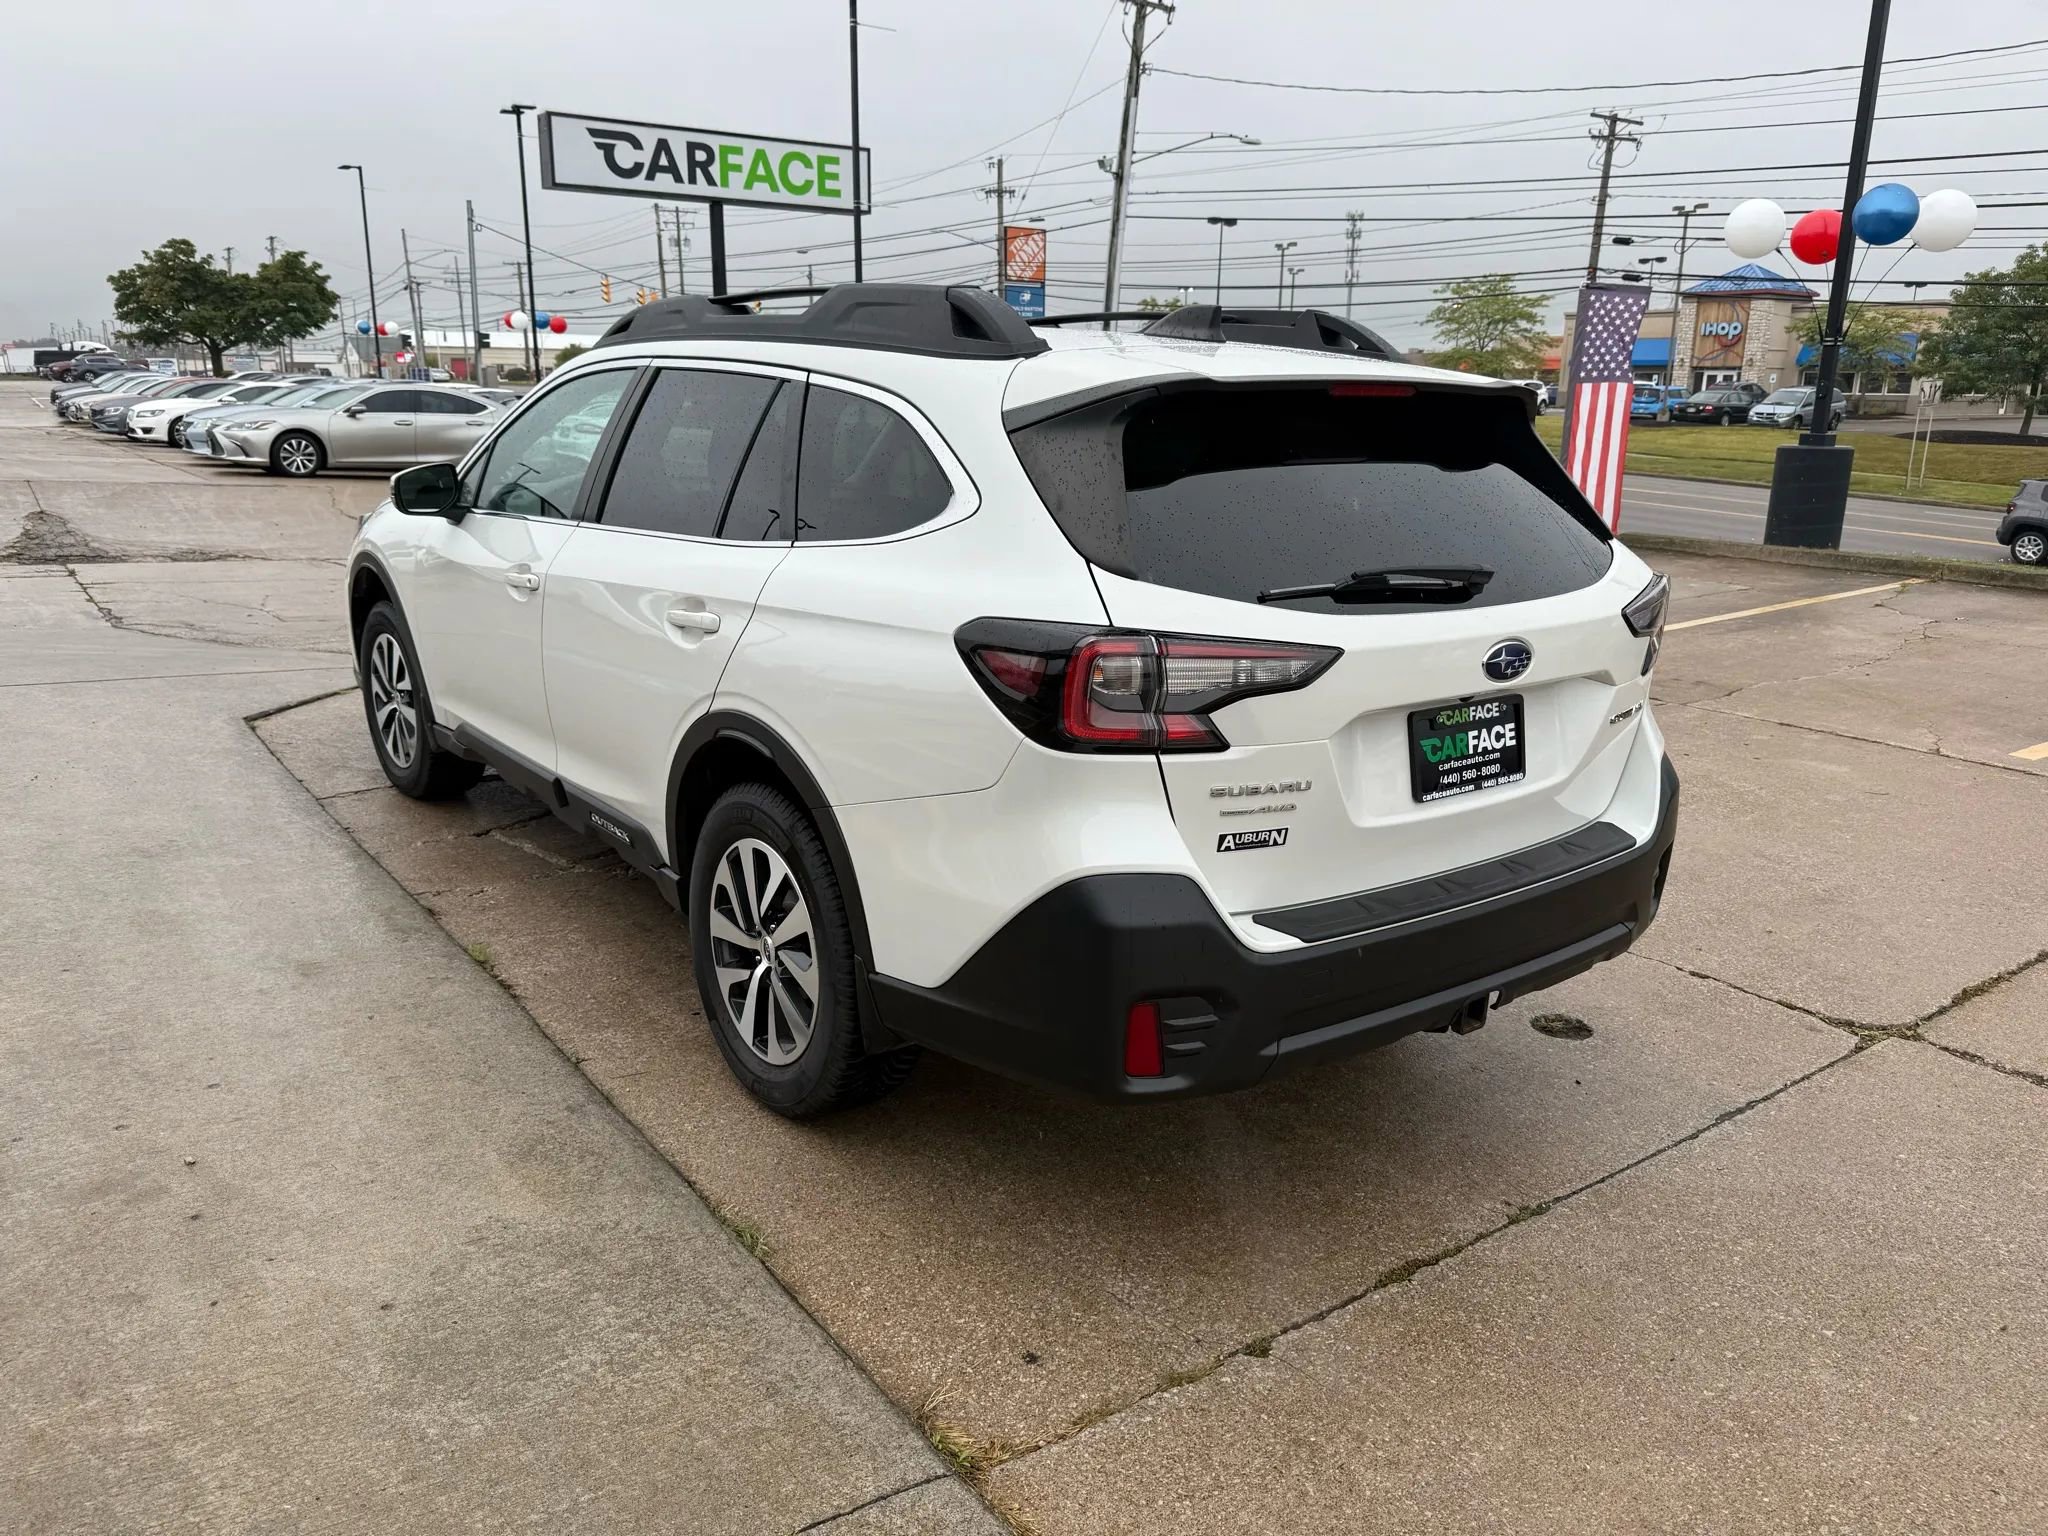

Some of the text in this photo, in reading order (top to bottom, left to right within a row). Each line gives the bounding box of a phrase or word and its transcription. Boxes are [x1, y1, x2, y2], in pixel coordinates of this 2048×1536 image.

[586, 127, 842, 198] CARFACE
[1440, 702, 1500, 726] CARFACE
[1420, 722, 1517, 763] CARFACE
[1438, 752, 1501, 771] carfaceauto.com
[1209, 780, 1312, 798] SUBARU
[1440, 772, 1460, 785] (440)
[1422, 784, 1475, 802] carfaceauto.com
[1481, 779, 1497, 790] (440)
[1219, 829, 1287, 851] AUBURN
